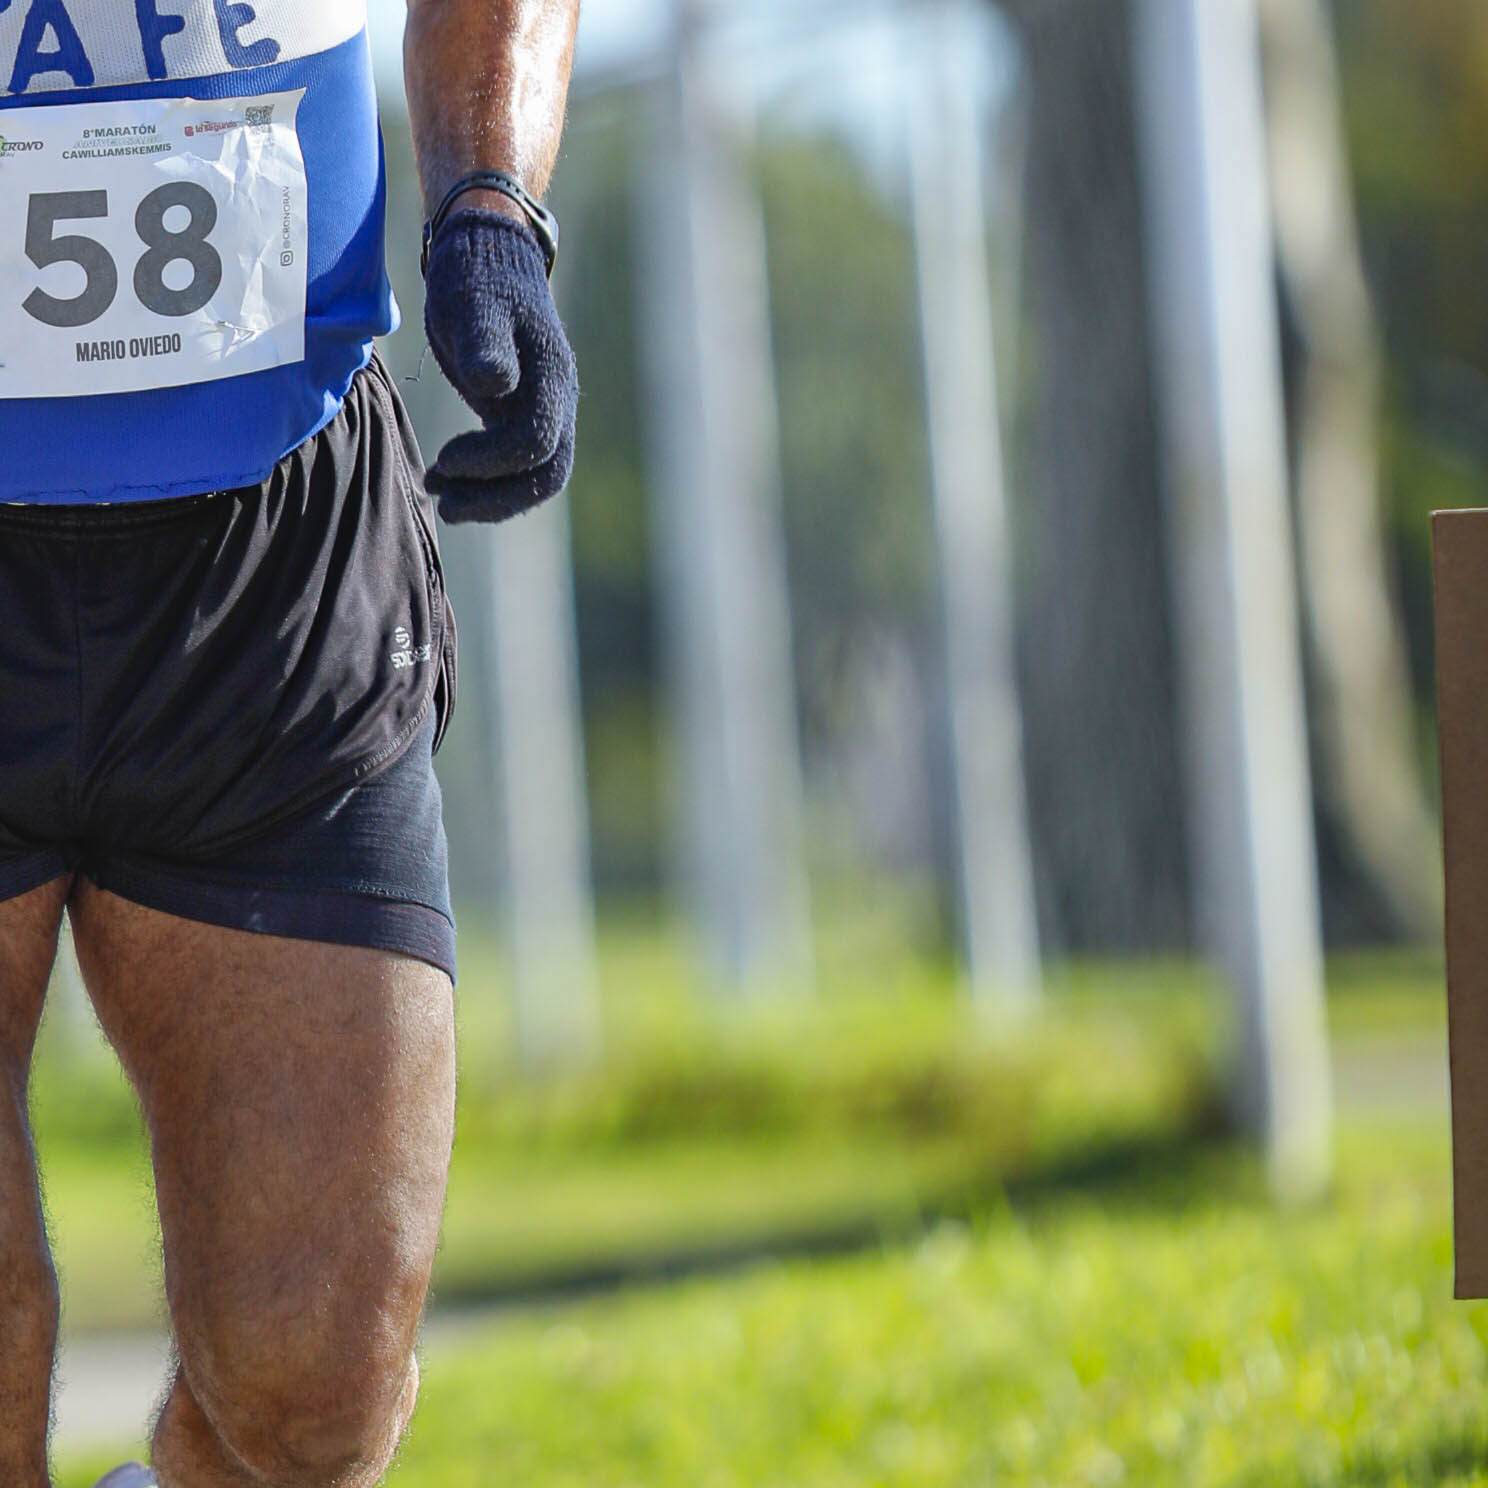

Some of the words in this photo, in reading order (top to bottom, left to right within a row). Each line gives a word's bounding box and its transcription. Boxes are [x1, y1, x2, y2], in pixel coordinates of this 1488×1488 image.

[21, 181, 223, 328] 58
[76, 340, 126, 362] MARIO
[129, 332, 182, 358] OVIEDO
